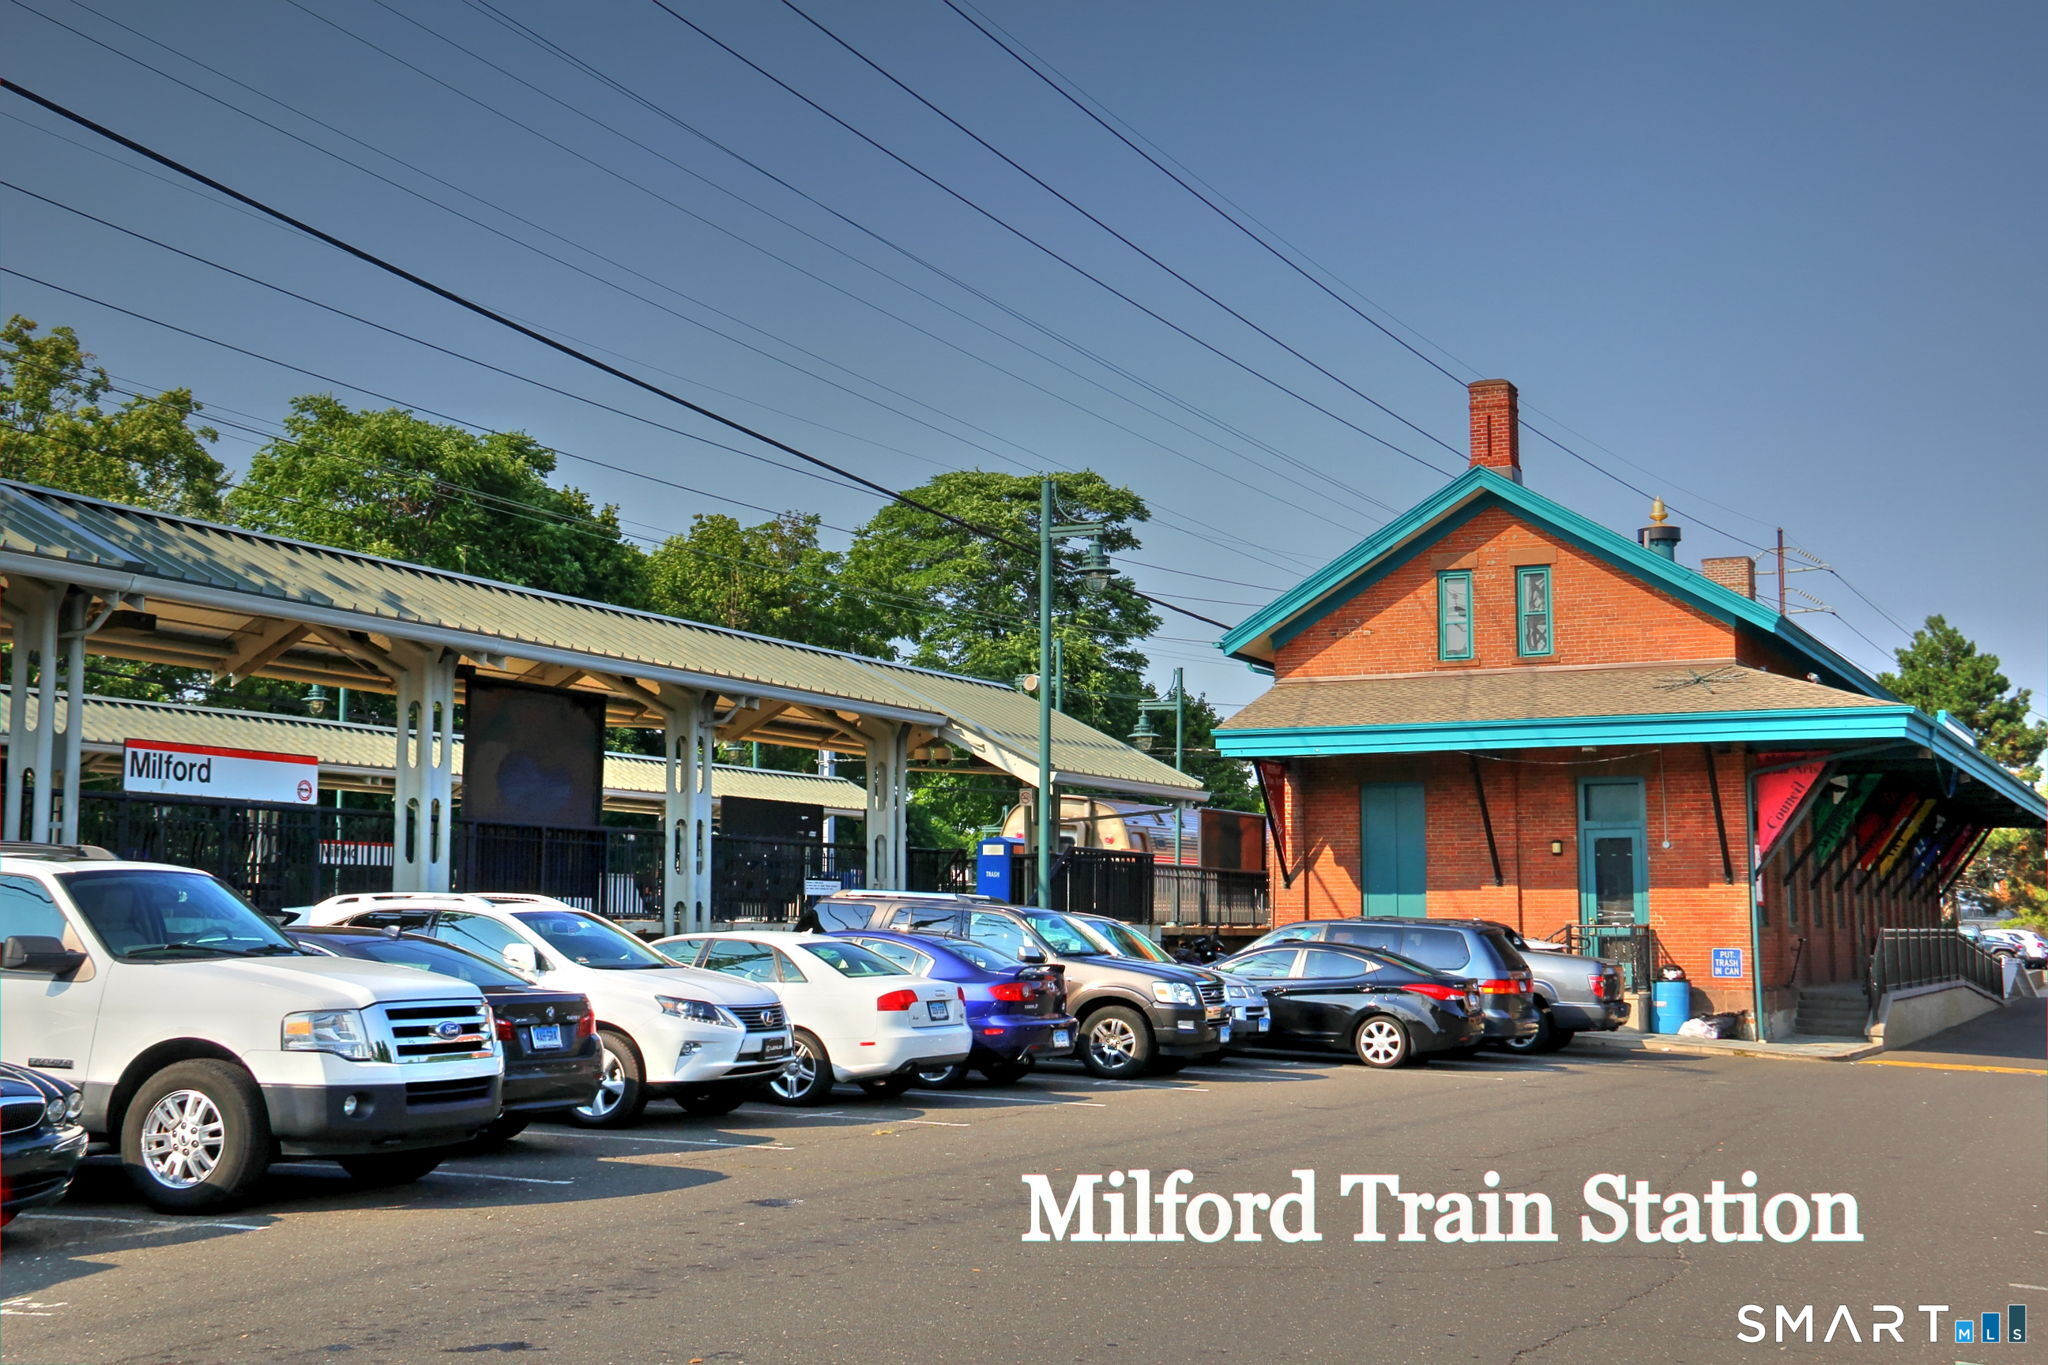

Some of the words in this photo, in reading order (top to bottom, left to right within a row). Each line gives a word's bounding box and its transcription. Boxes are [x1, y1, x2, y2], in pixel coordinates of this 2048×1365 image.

[130, 751, 211, 783] Milford
[1767, 781, 1806, 829] Council
[1715, 959, 1739, 967] TRASH
